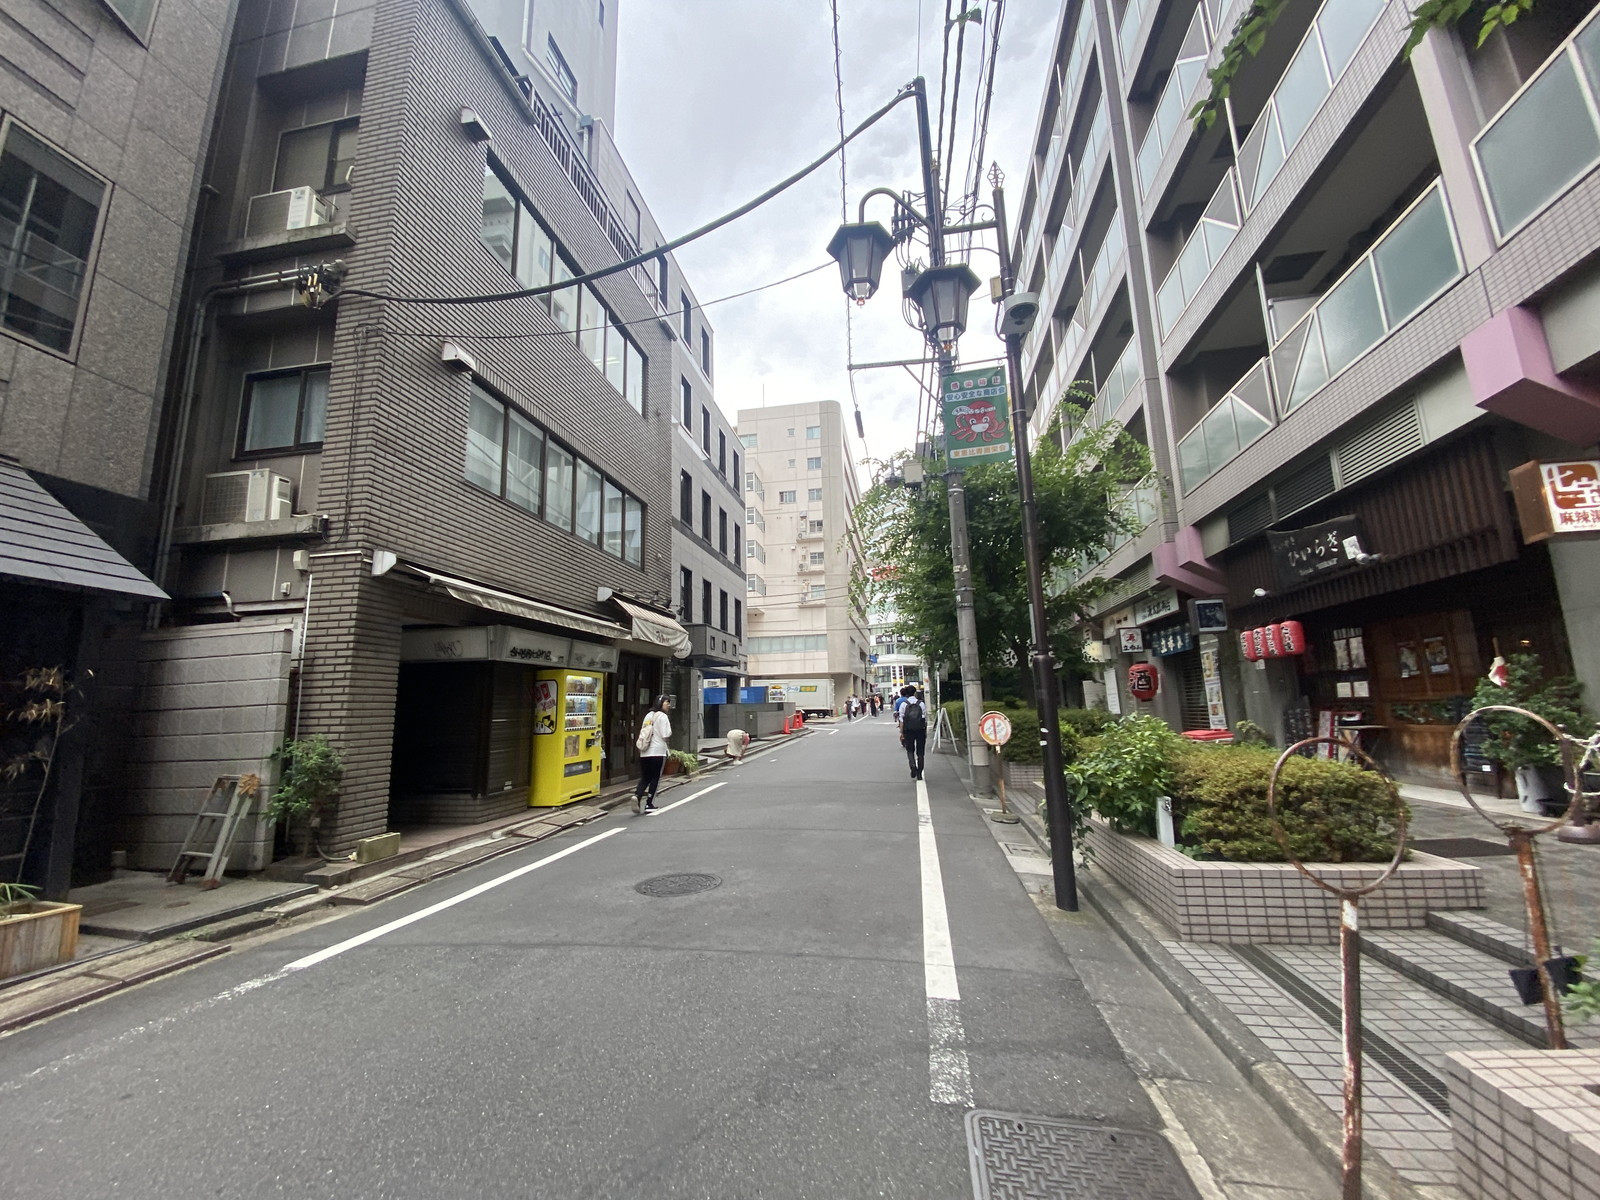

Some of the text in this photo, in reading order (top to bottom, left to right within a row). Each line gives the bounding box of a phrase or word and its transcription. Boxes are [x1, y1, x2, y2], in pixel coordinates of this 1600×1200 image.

[946, 387, 1005, 402] 安心安全な商店会
[1288, 530, 1338, 567] ひいらぎ
[1128, 670, 1154, 691] 酒
